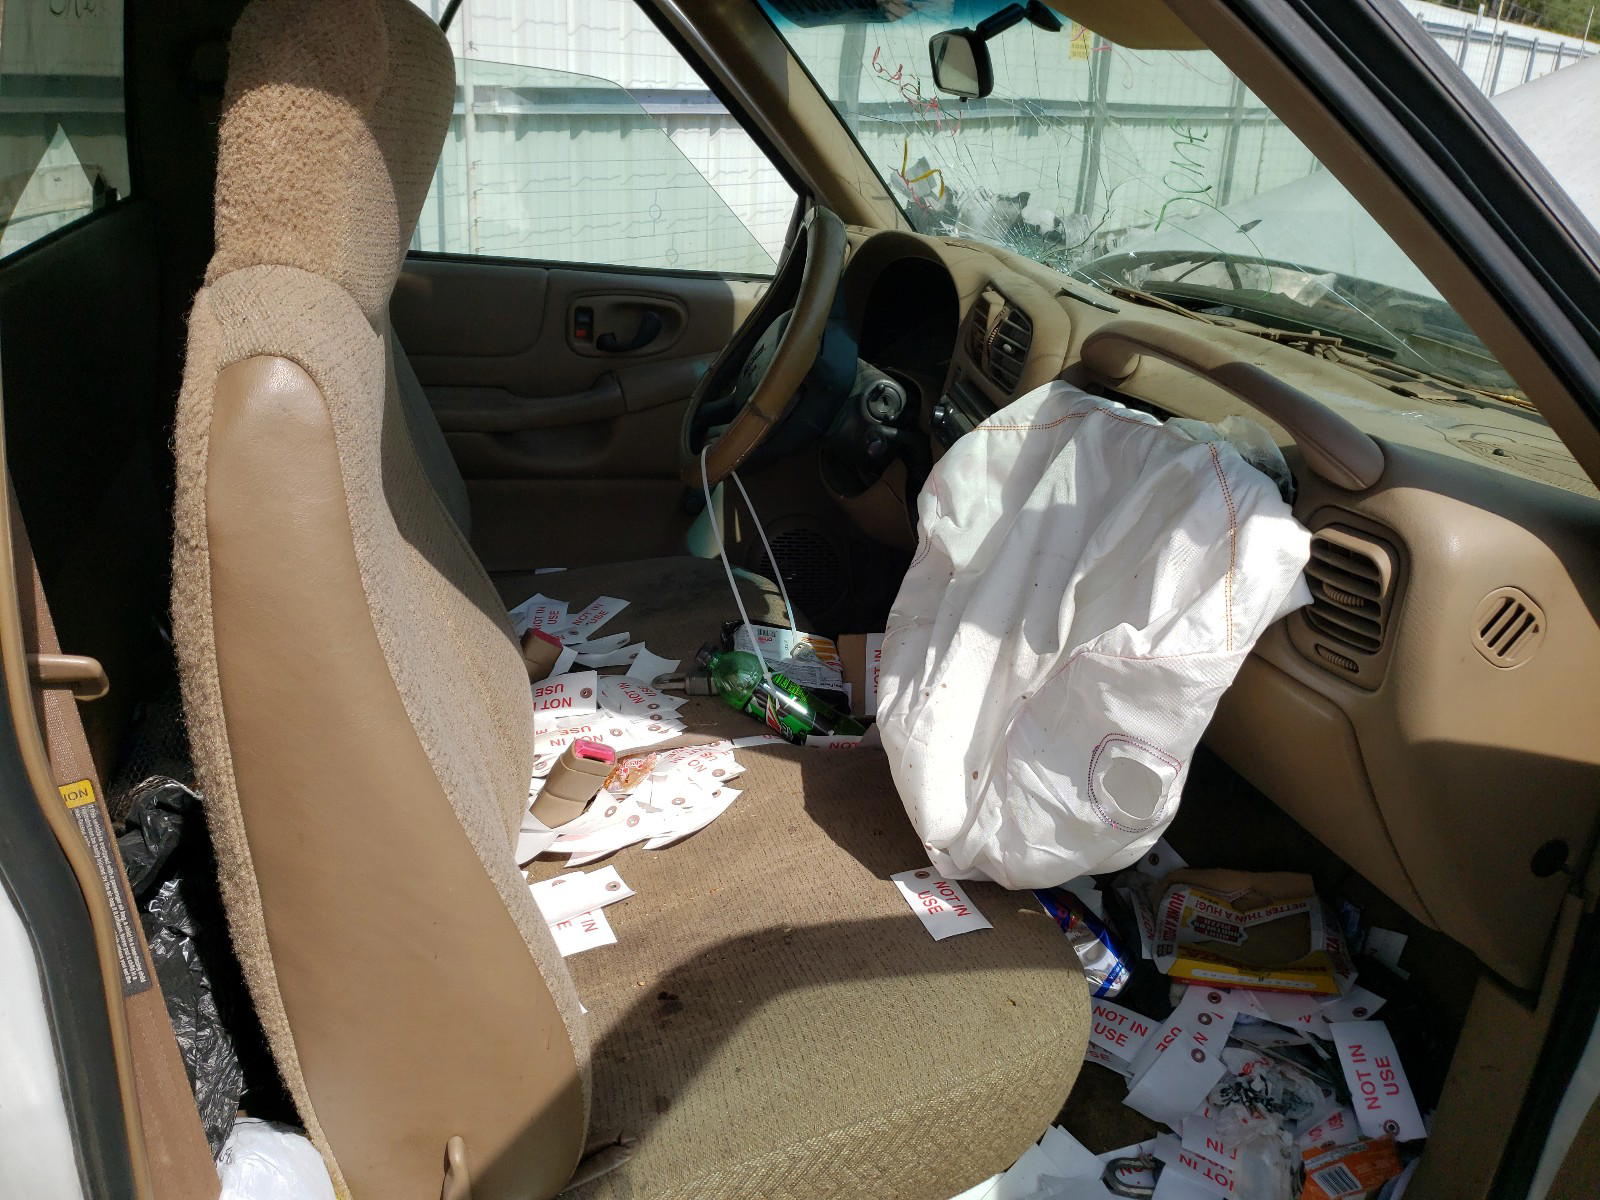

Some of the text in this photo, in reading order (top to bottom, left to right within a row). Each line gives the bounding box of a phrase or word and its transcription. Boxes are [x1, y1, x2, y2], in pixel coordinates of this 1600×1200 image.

[535, 683, 564, 698] USE
[540, 697, 572, 710] NOT
[559, 725, 592, 736] USE
[917, 890, 944, 915] USE
[933, 880, 971, 917] NOT IN
[1093, 1005, 1149, 1037] NOT IN
[1093, 1022, 1128, 1047] USE
[1348, 1044, 1382, 1111] NOT IN
[1374, 1055, 1400, 1096] USE
[1206, 1136, 1224, 1155] IN
[1179, 1153, 1198, 1170] IN
